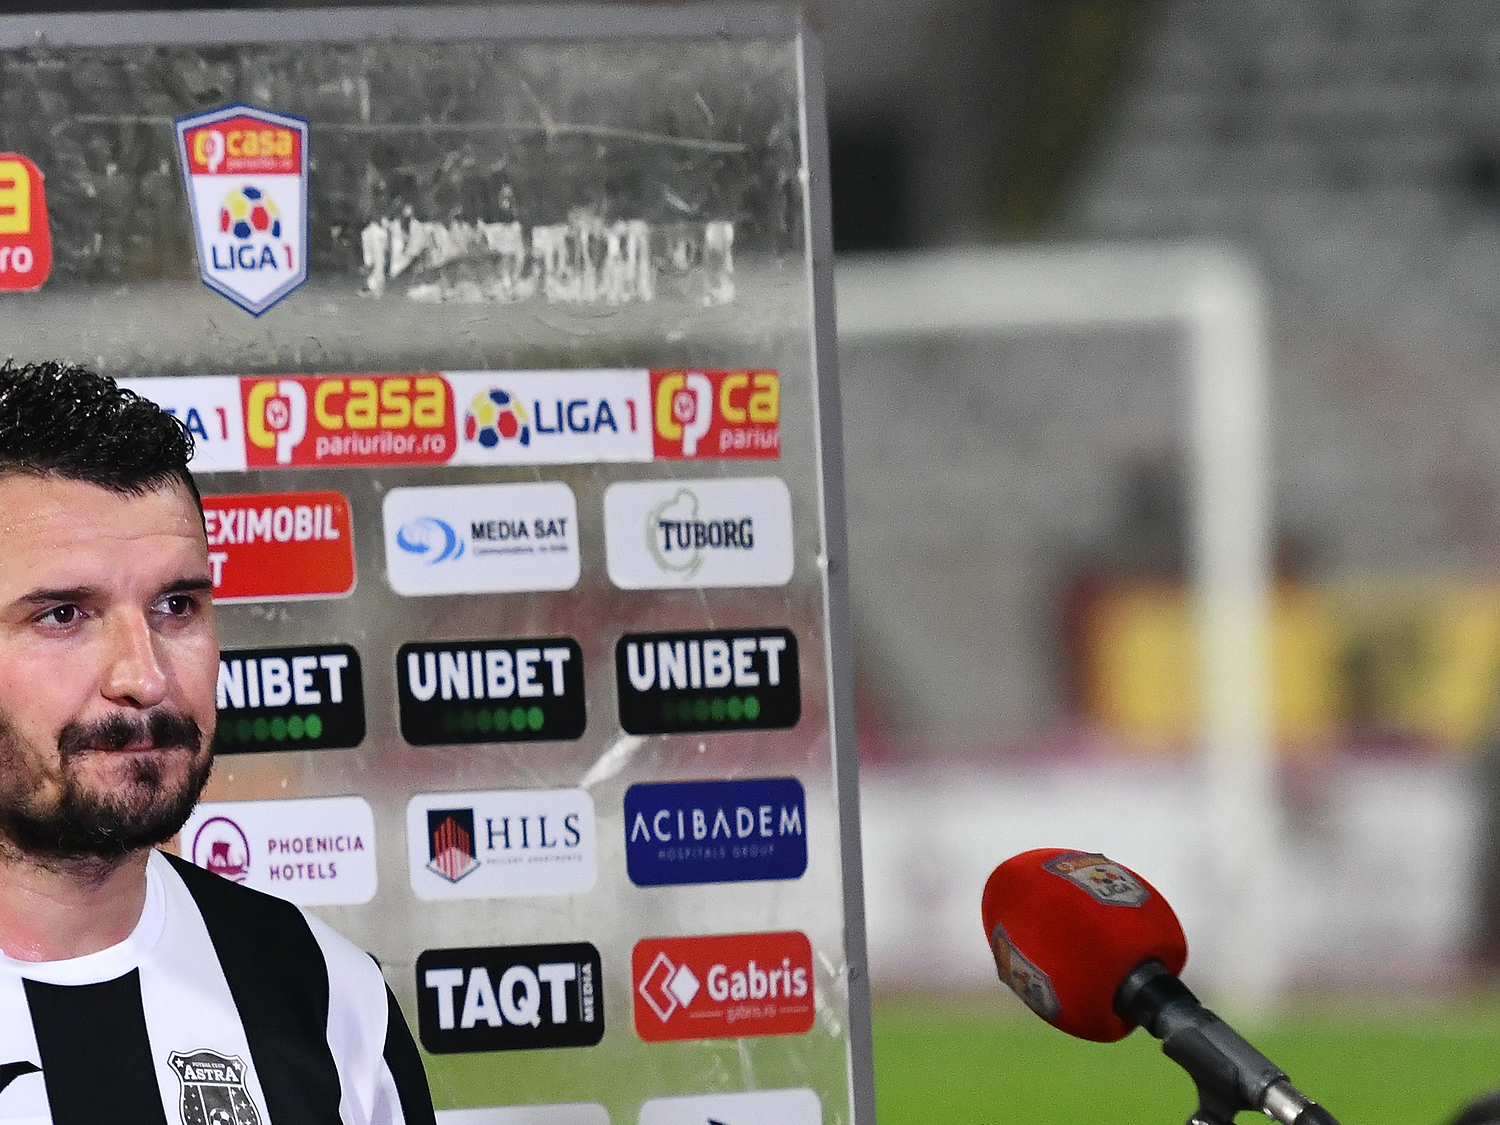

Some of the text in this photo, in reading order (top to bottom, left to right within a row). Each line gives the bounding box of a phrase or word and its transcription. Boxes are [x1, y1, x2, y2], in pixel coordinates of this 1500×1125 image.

[226, 130, 293, 157] casa
[212, 245, 293, 270] LIGA 1
[314, 378, 446, 429] casa
[534, 398, 638, 434] LIGA 1
[216, 406, 229, 442] 1
[315, 431, 446, 460] pariurilor.ro
[203, 504, 341, 545] EXIMOBIL
[471, 517, 568, 542] MEDIA SAT
[659, 518, 754, 552] TUBORG
[216, 654, 349, 710] NIBET
[407, 647, 571, 701] UNIBET
[626, 637, 787, 691] UNIBET
[486, 813, 581, 850] HILS
[630, 805, 803, 843] ACIBADEM
[267, 834, 365, 855] PHOENICIA
[268, 860, 339, 881] HOTELS
[425, 962, 577, 1030] TAQT
[707, 957, 808, 1002] Gabris
[184, 1064, 240, 1082] ASTRA
